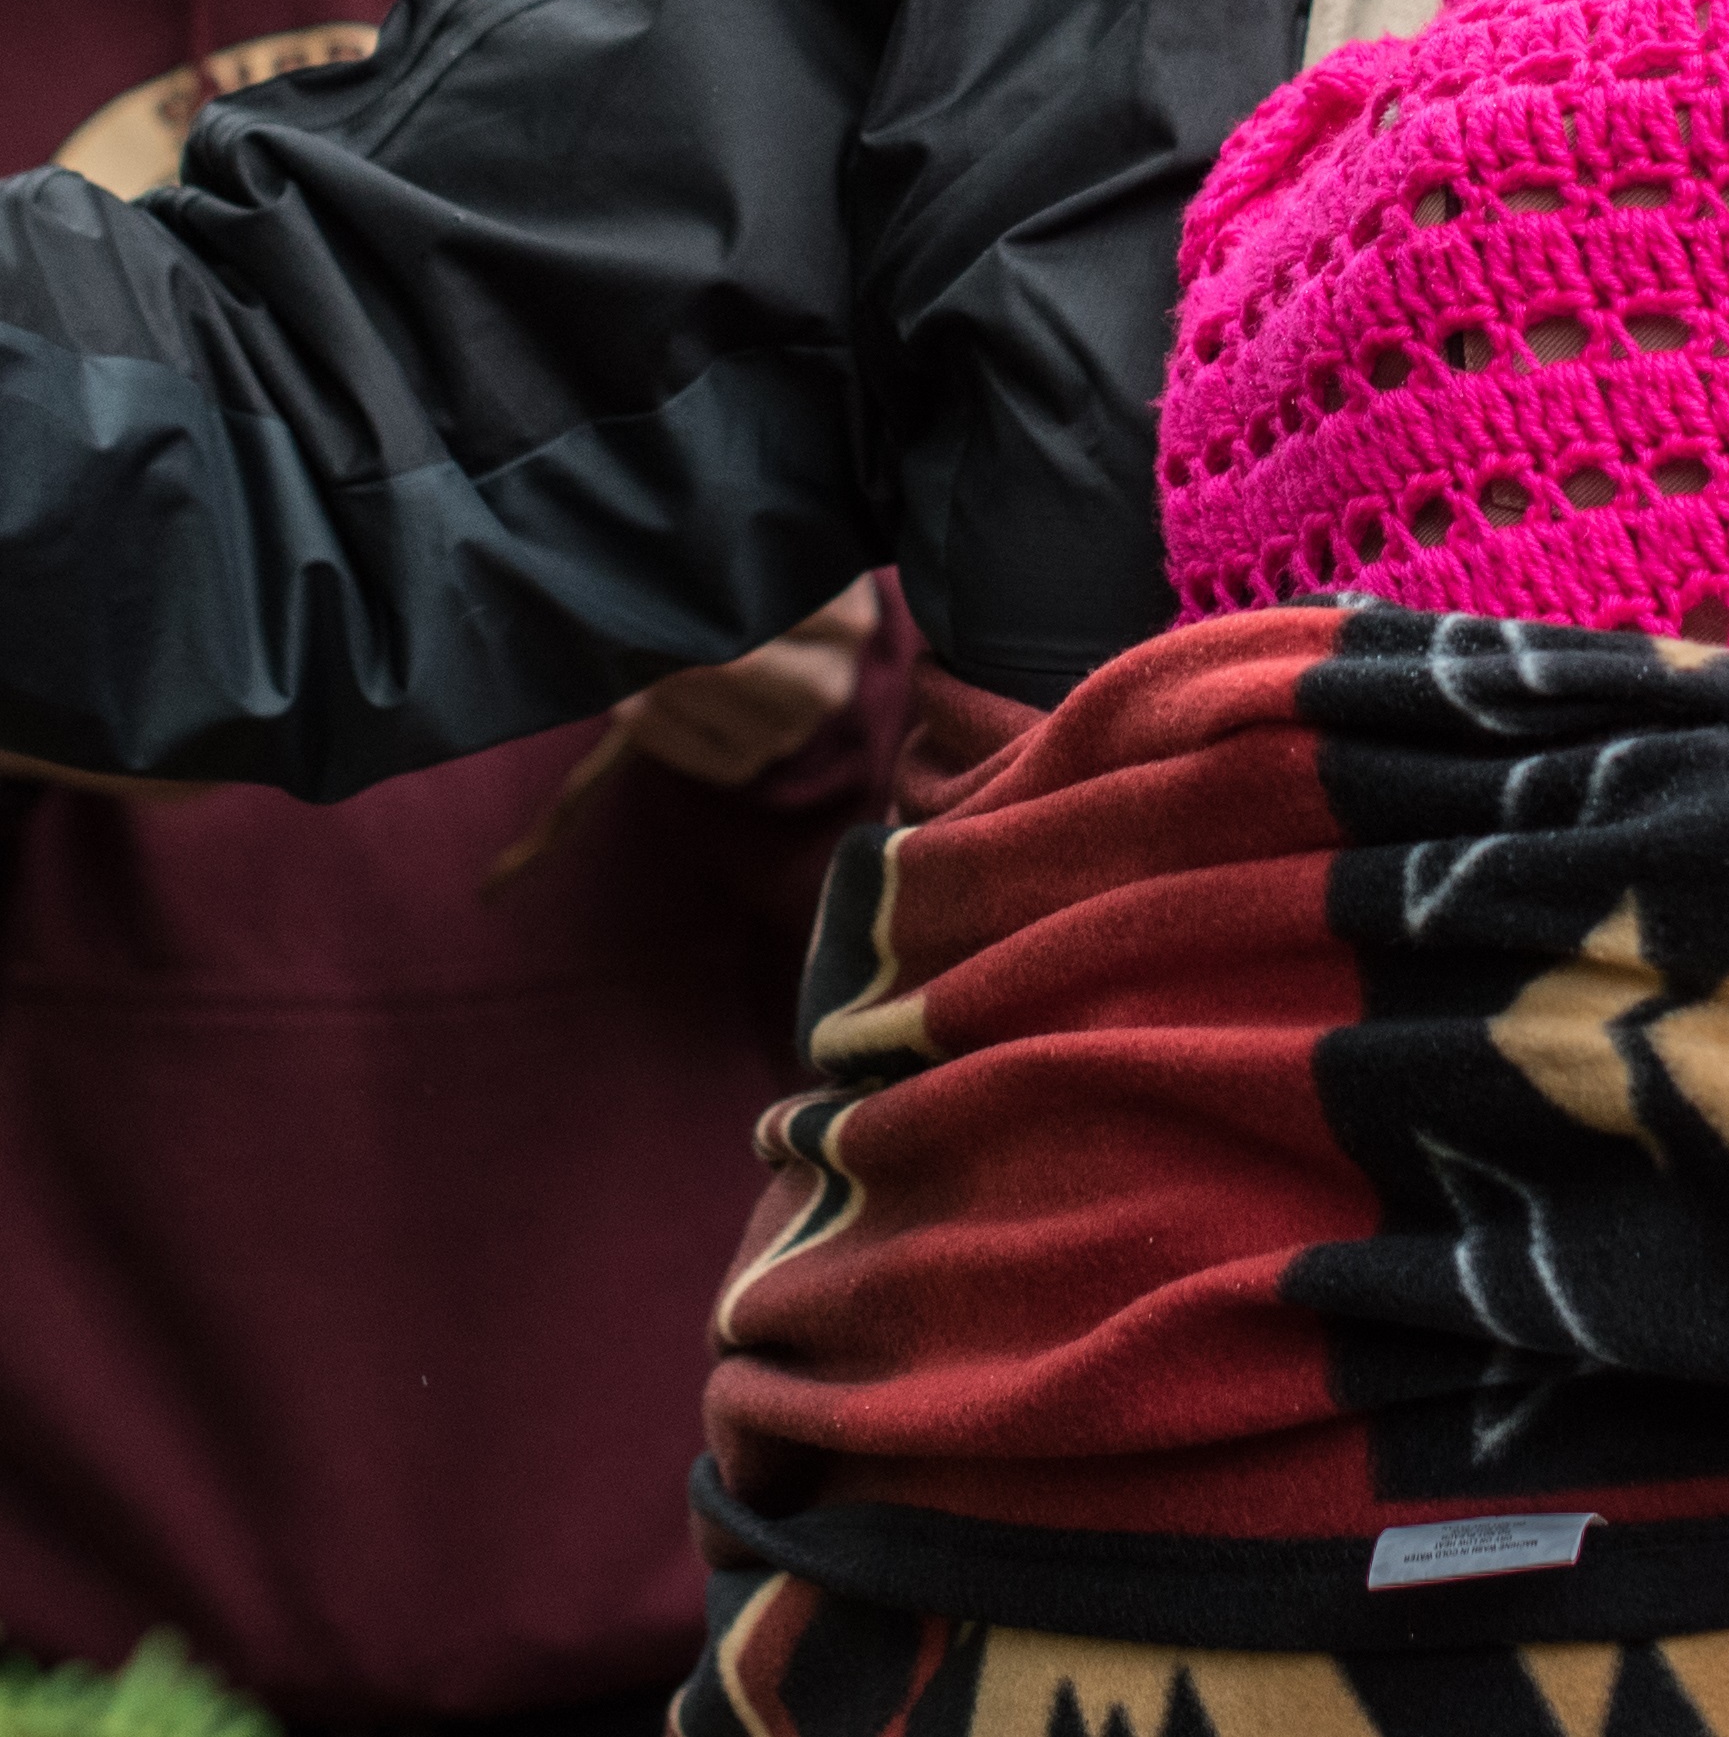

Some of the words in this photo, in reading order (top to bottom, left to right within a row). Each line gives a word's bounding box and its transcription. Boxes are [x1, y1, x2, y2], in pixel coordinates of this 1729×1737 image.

[1434, 1540, 1457, 1551] HEAT
[1471, 1545, 1496, 1554] WASH
[1501, 1540, 1538, 1550] MACHINE
[1435, 1549, 1459, 1559] COLD
[1460, 1547, 1470, 1555] IN
[1403, 1552, 1433, 1563] WATER
